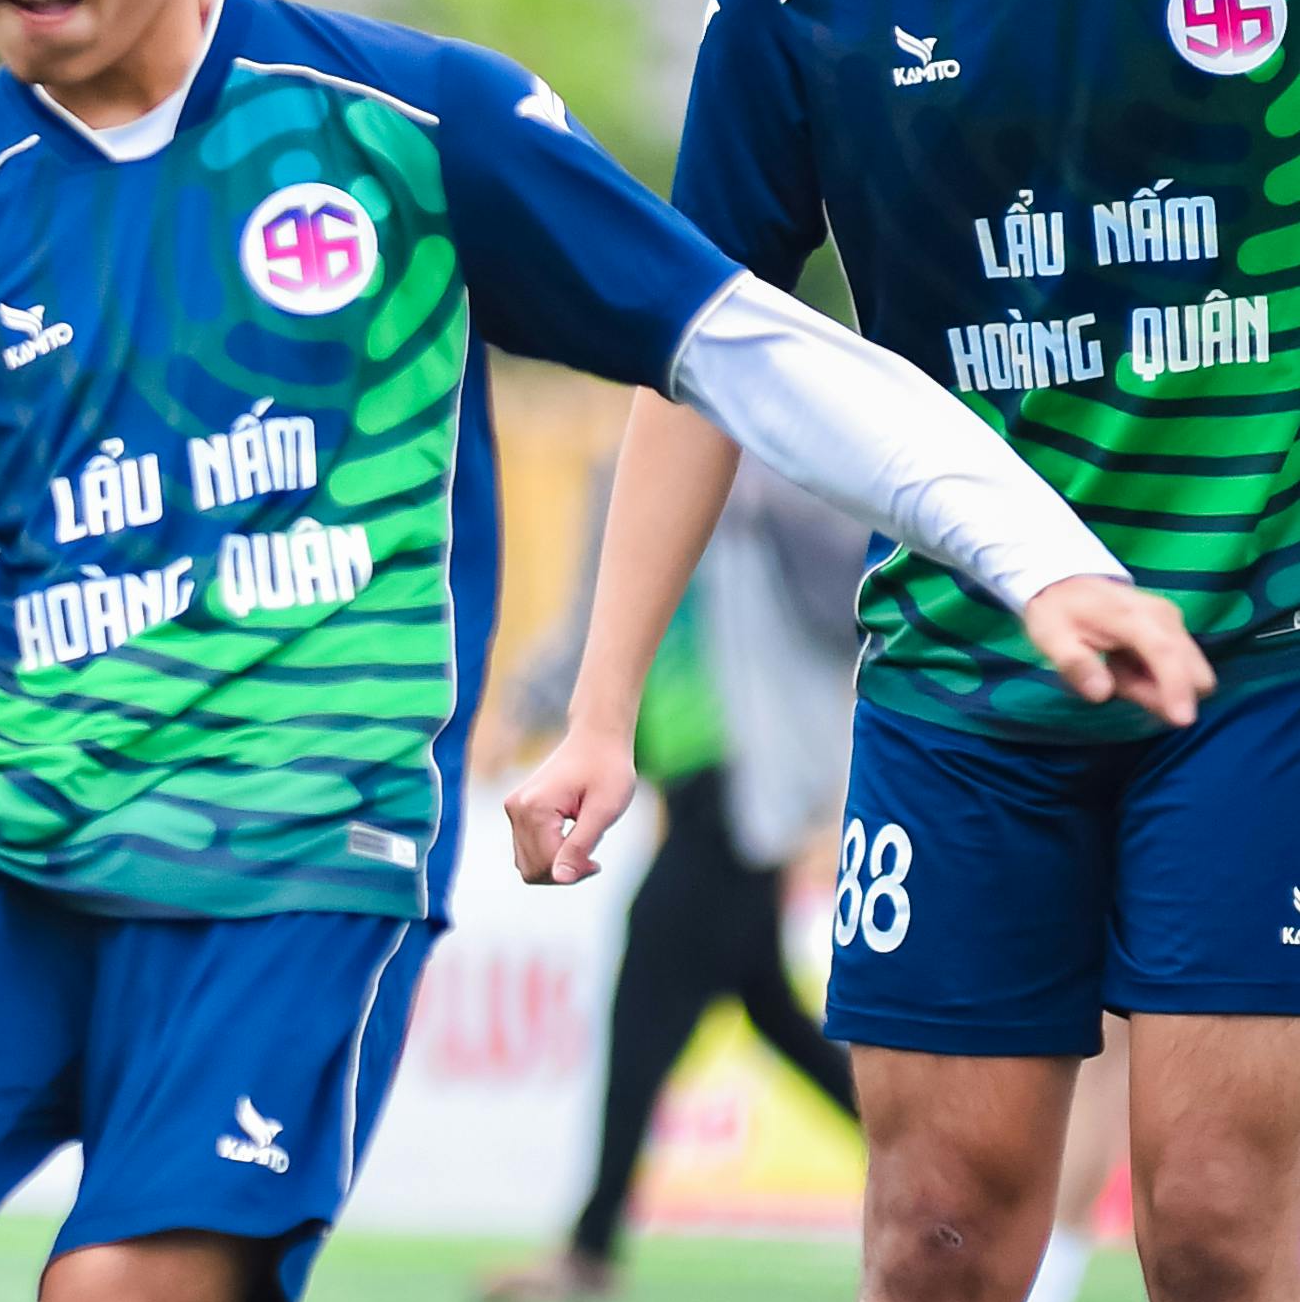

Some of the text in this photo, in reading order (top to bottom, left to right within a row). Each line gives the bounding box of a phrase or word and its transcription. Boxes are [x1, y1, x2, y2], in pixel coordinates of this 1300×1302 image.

[893, 59, 960, 86] KAMITO
[262, 202, 362, 292] 96
[975, 178, 1219, 279] LẨU NẤM
[947, 288, 1270, 392] HOÀNG QUÂN
[51, 395, 318, 544] LẨU NẤM
[14, 515, 373, 673] HOÀNG QUÂN
[834, 817, 913, 953] 88
